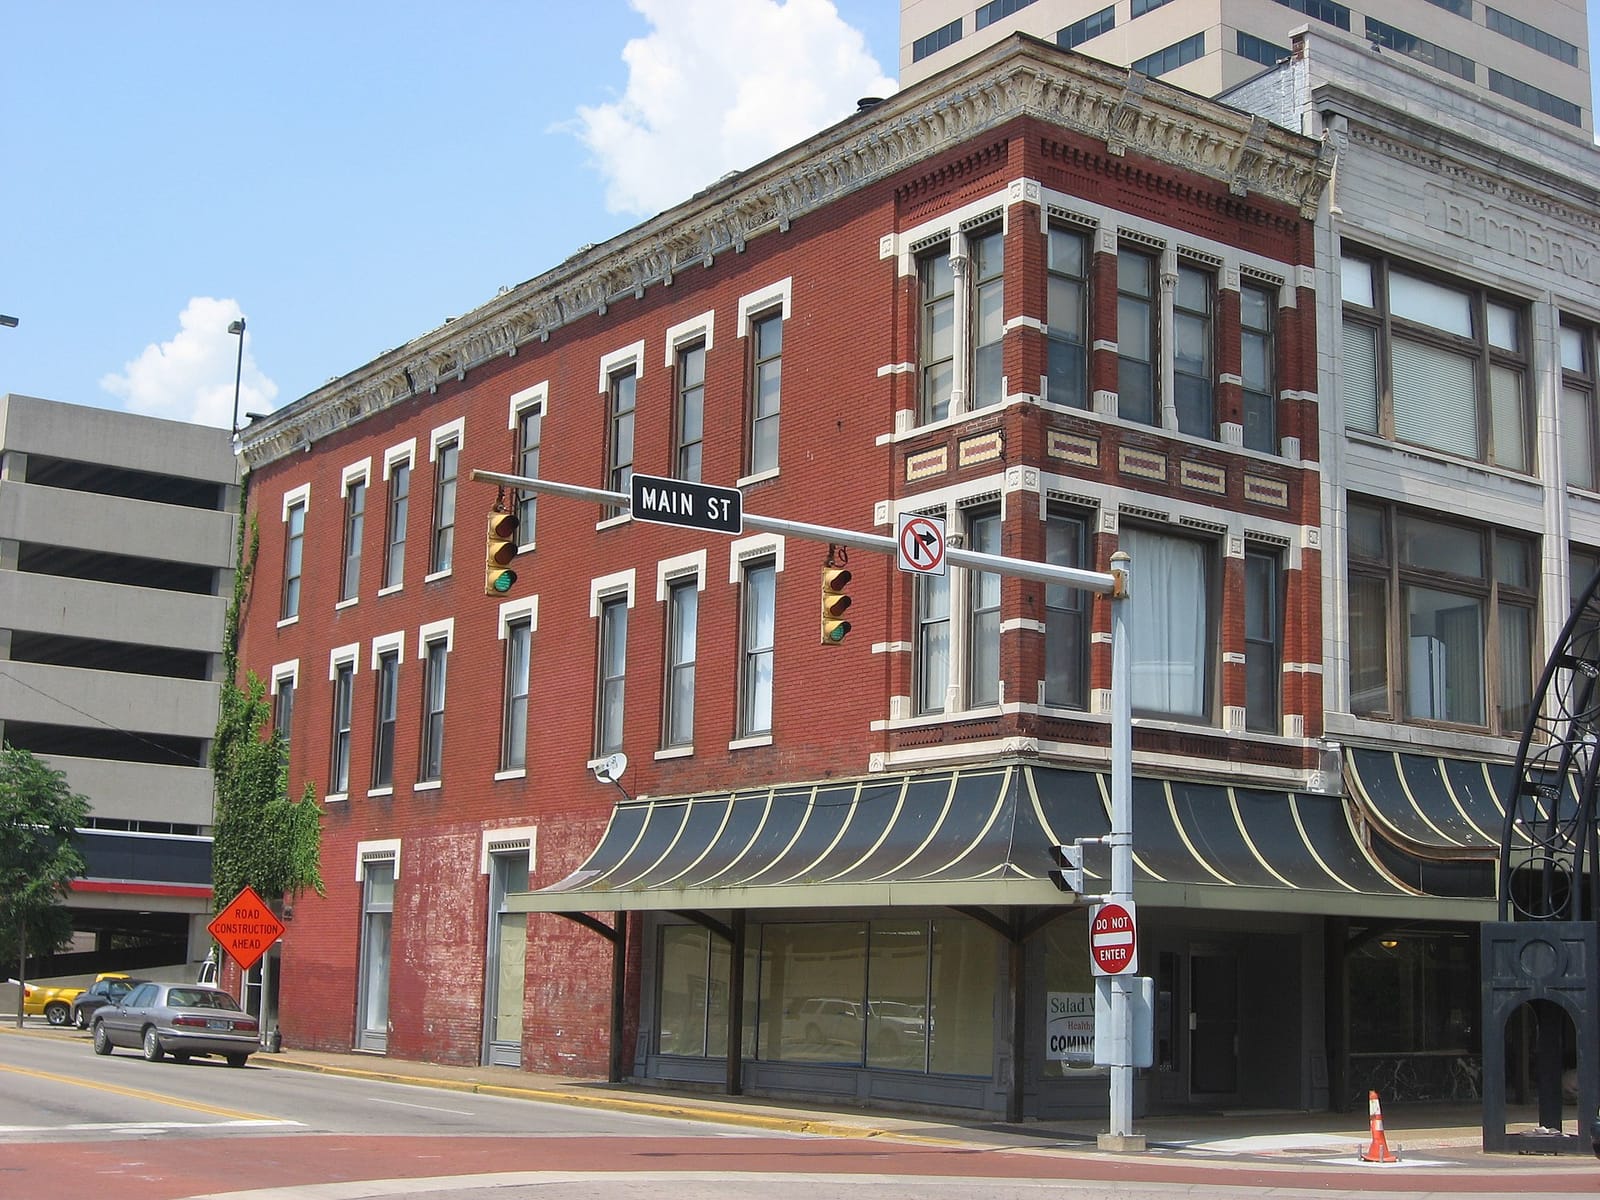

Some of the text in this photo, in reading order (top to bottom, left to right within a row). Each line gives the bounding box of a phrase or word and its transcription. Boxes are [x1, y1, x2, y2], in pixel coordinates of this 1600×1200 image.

[642, 487, 731, 521] MAIN ST
[235, 909, 260, 919] ROAD
[215, 924, 278, 934] CONSTRUCTION
[1096, 917, 1129, 930] DO NOT
[232, 939, 261, 949] AHEAD
[1100, 948, 1126, 960] ENTER
[1051, 997, 1085, 1013] Salad
[1067, 1021, 1095, 1032] Healthy
